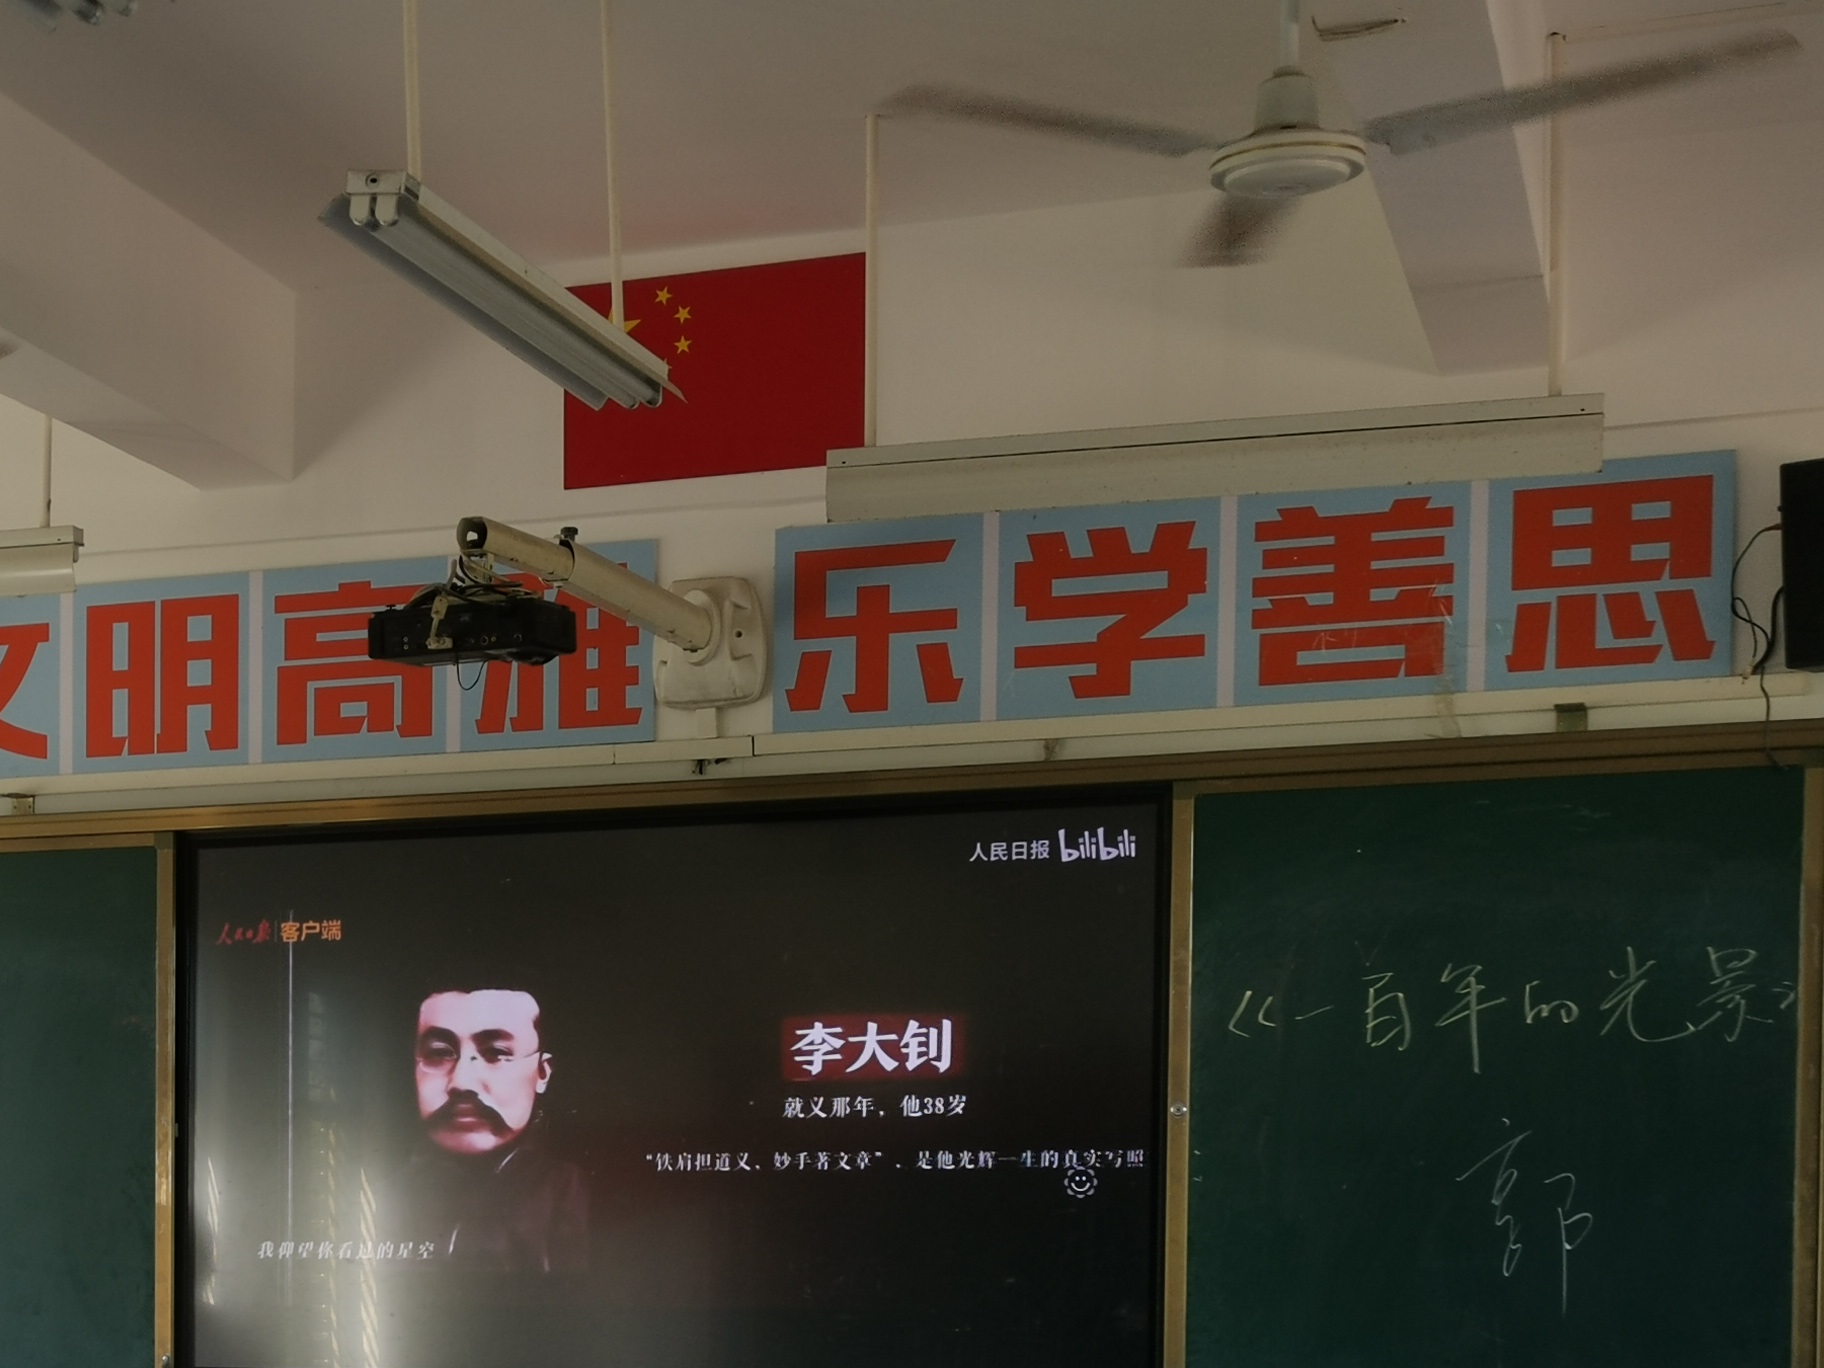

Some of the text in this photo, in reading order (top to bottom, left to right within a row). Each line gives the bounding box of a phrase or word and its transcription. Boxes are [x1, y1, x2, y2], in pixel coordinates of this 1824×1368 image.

[784, 474, 1717, 715] 乐学善思
[969, 826, 1136, 863] 人民日报 bilibili
[280, 919, 342, 943] 客户端
[791, 1018, 954, 1076] 李大钊
